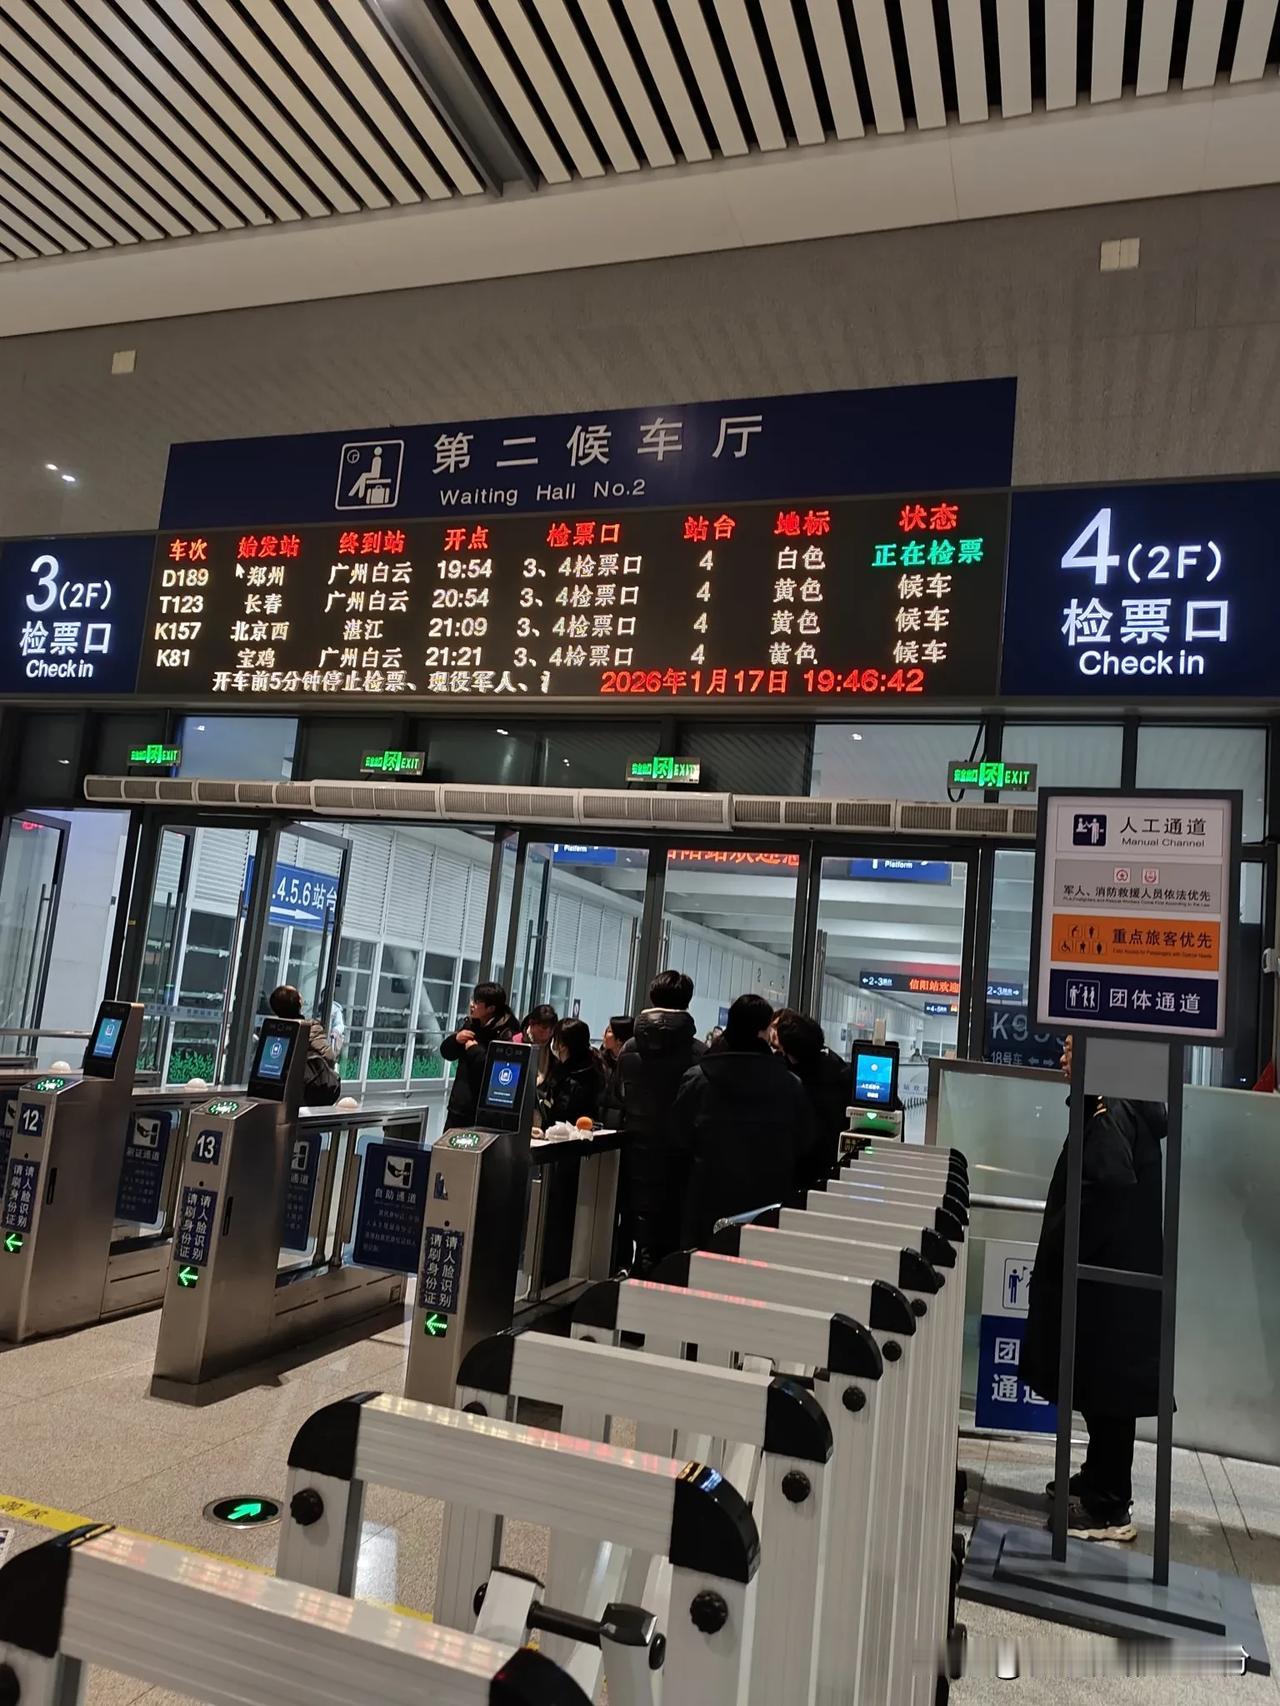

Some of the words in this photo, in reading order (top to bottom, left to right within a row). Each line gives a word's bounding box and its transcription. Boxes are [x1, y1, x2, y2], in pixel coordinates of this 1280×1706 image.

[433, 415, 763, 474] 第二候车厅
[440, 487, 518, 507] Waiting
[537, 482, 575, 501] Hall
[594, 479, 646, 498] No.2
[169, 538, 208, 561] 车次
[237, 534, 300, 559] 始发站
[338, 530, 406, 555] 终到站
[444, 525, 489, 551] 开点
[547, 521, 621, 547] 检票口
[683, 513, 736, 542] 站台
[774, 510, 830, 536] 地标
[899, 503, 958, 532] 状态
[162, 568, 209, 588] D189
[246, 566, 285, 588] 郑州
[328, 561, 412, 584] 广州白云
[437, 558, 493, 579] 19:54
[699, 550, 713, 571] 4
[777, 545, 826, 571] 白色
[871, 537, 984, 568] 正在检票
[159, 595, 204, 614] T123
[244, 592, 282, 615] 长春
[324, 588, 410, 612] 广州白云
[432, 587, 489, 608] 20:54
[696, 580, 711, 602] 4
[774, 577, 823, 602] 黄色
[898, 572, 952, 599] 候车
[154, 621, 202, 641] K157
[230, 620, 290, 642] 北京西
[343, 619, 384, 641] 湛江
[428, 617, 488, 638] 21:09
[693, 612, 708, 633] 4
[770, 608, 821, 635] 黄色
[895, 605, 950, 632] 候车
[1061, 597, 1229, 646] 检票口
[19, 620, 112, 656] 检票口
[156, 648, 191, 668] K81
[236, 647, 276, 669] 宝鸡
[318, 646, 403, 669] 广州白云
[425, 646, 483, 667] 21:21
[690, 644, 706, 665] 4
[769, 640, 818, 666] 黄色
[893, 638, 947, 664] 候车
[1079, 650, 1173, 675] Check
[1179, 649, 1204, 675] in
[26, 660, 77, 678] Check
[78, 658, 94, 678] in
[600, 667, 789, 695] 2026年1月17日
[803, 667, 924, 693] 19:46:42
[162, 750, 178, 761] EXIT
[401, 757, 420, 769] EXIT
[673, 763, 697, 777] EXIT
[1004, 770, 1030, 785] EXIT
[1120, 816, 1206, 836] 人工通道
[1122, 837, 1160, 846] Manual
[1162, 839, 1205, 848] Channel
[884, 860, 913, 869] Platform
[1063, 884, 1211, 902] 军人、消防救援人员依法优先
[1113, 928, 1212, 948] 重点旅客优先
[1109, 987, 1200, 1014] 团体通道
[22, 1108, 40, 1132] 12
[197, 1135, 216, 1159] 13
